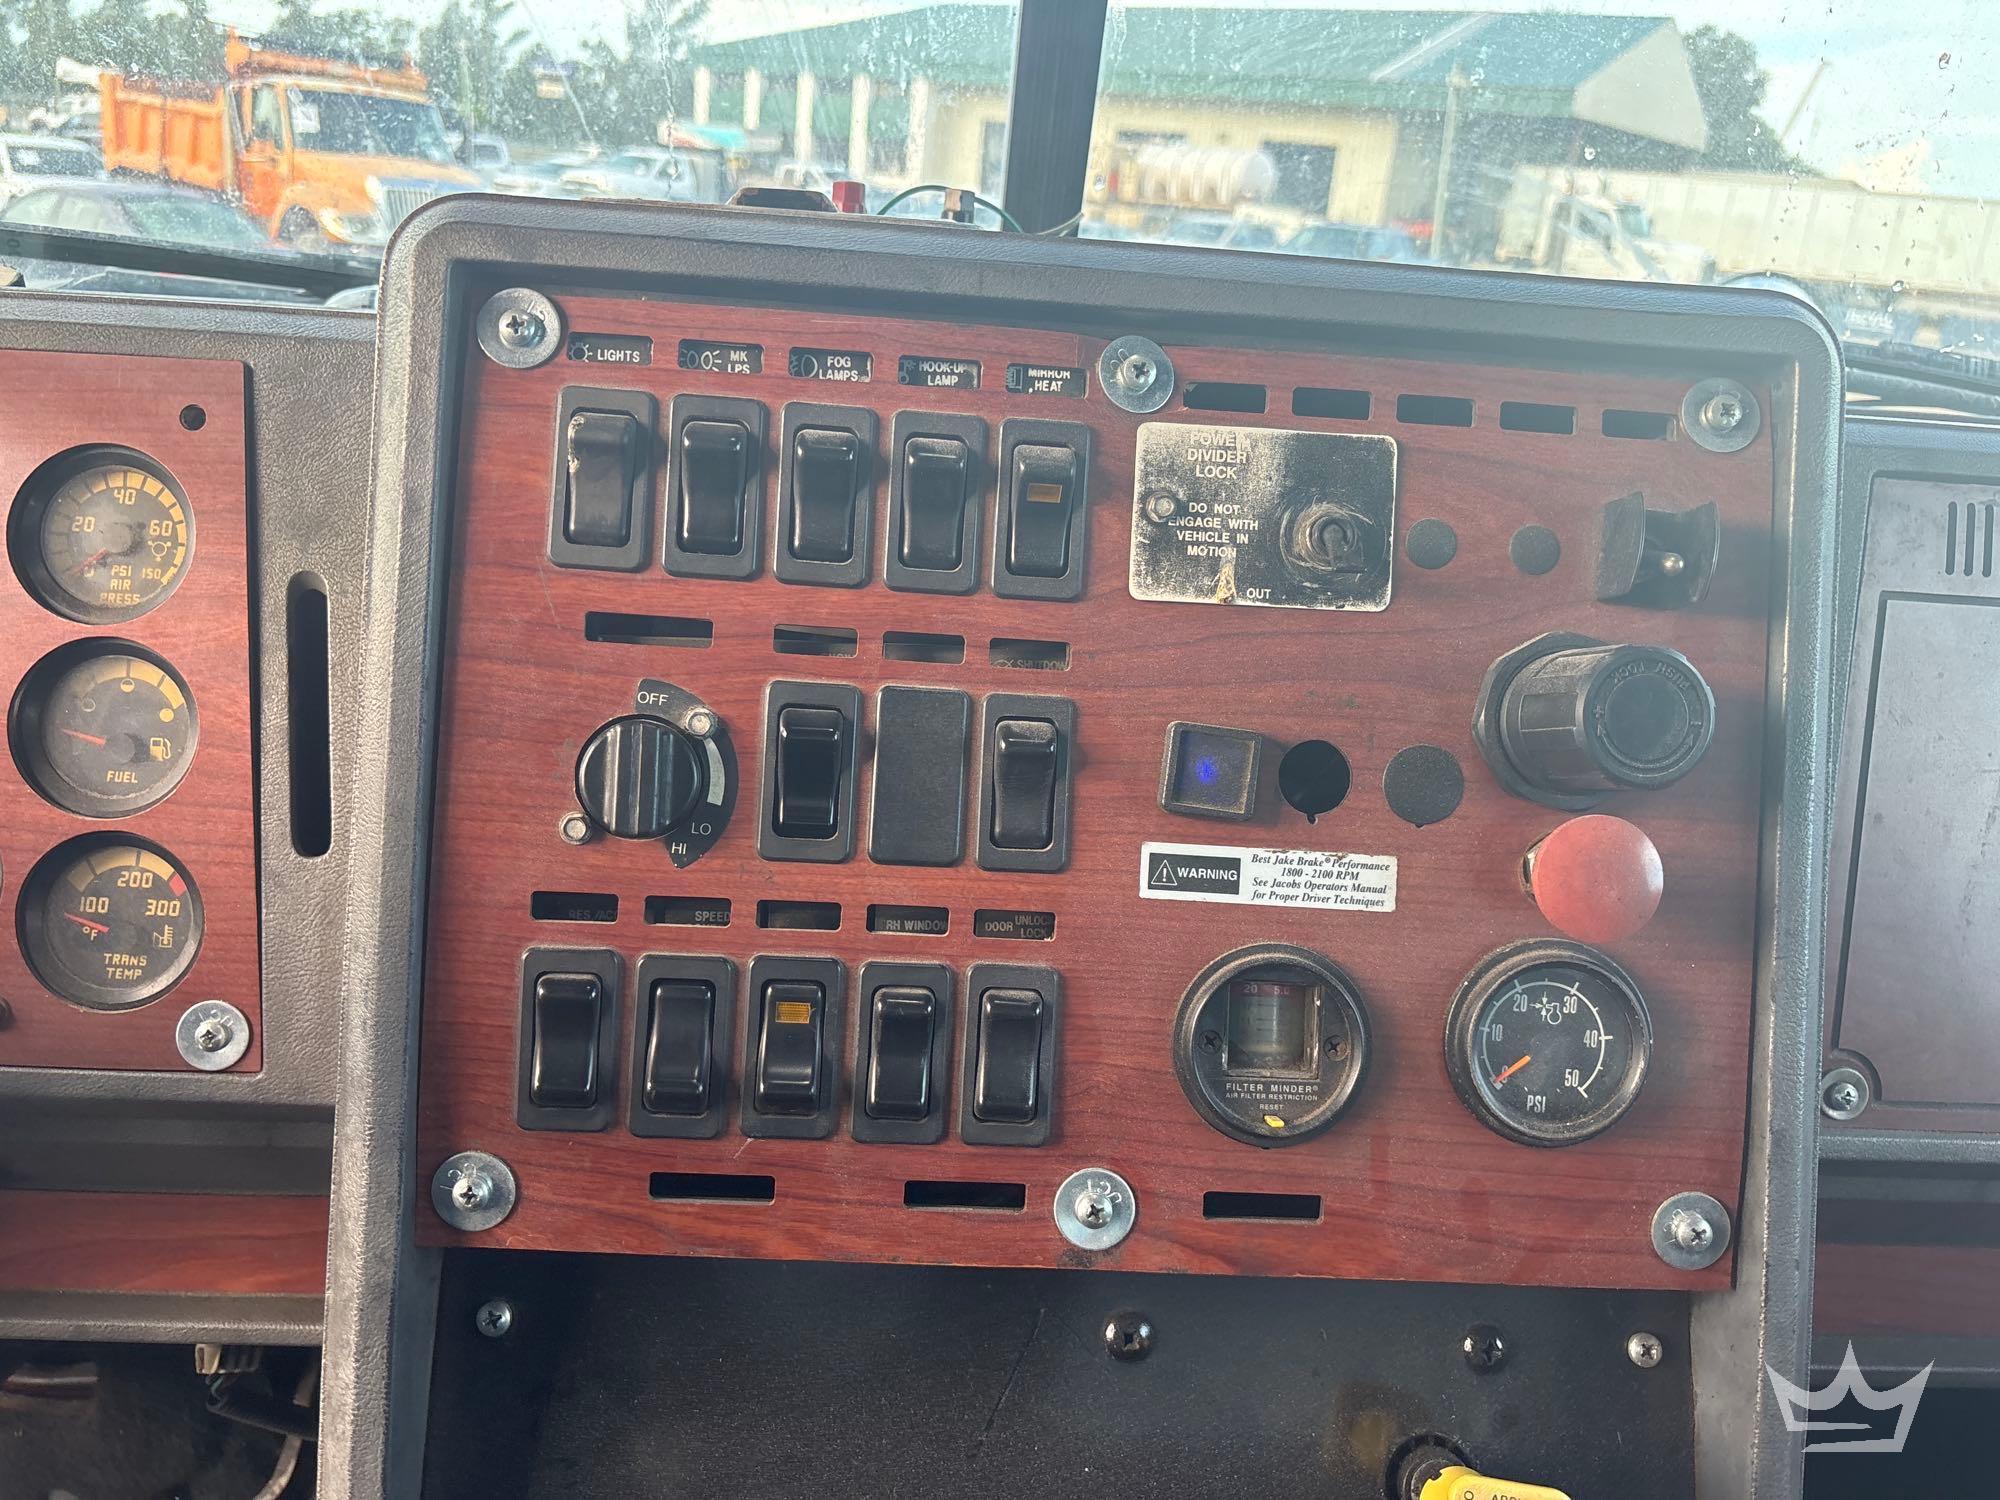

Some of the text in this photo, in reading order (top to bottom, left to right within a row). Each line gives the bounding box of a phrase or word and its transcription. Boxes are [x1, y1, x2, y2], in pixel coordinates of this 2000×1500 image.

[597, 348, 640, 362] LIGHTS
[730, 350, 748, 362] MK
[827, 356, 851, 368] FOG
[727, 363, 750, 374] LPS
[918, 360, 968, 374] HOOK-UP
[818, 368, 858, 382] LAMPS
[927, 374, 958, 386] LAMP
[1035, 380, 1062, 392] HEAT
[1187, 448, 1247, 464] DIVIDER
[1195, 466, 1237, 480] LOCK
[114, 489, 136, 506] 40
[1188, 502, 1240, 515] DO NOT
[72, 516, 95, 532] 20
[150, 520, 173, 536] 60
[1168, 516, 1258, 531] ENGAGE WITH
[1177, 530, 1248, 544] VEHICLE IN
[1187, 545, 1236, 558] MOTION
[111, 564, 132, 576] PSI
[141, 568, 161, 580] 150
[110, 579, 131, 590] AIR
[100, 592, 140, 604] PRESS
[1246, 588, 1272, 600] OUT
[637, 691, 669, 706] OFF
[106, 770, 138, 784] FUEL
[692, 822, 712, 836] LO
[672, 843, 687, 854] HI
[1251, 854, 1271, 864] Best
[1273, 854, 1294, 866] Jake
[1332, 858, 1390, 872] Performance
[117, 871, 154, 888] 200
[1177, 866, 1238, 881] WARNING
[1281, 868, 1302, 878] 1800
[1312, 868, 1333, 879] 2100
[1336, 870, 1360, 881] RPM
[1252, 877, 1388, 894] See Jacobs Operators Manual
[80, 896, 110, 914] 100
[1252, 890, 1385, 908] for Proper Driver Techniques
[144, 899, 181, 917] 300
[695, 910, 731, 922] SPEED
[985, 914, 1051, 932] DOOR UNLOC
[886, 920, 901, 930] RH
[104, 953, 148, 966] TRANS
[106, 968, 142, 980] TEMP
[1513, 994, 1528, 1012] 20
[1563, 996, 1577, 1014] 30
[1491, 1024, 1503, 1042] 10
[1584, 1030, 1598, 1048] 40
[1565, 1069, 1580, 1088] 50
[1226, 1082, 1264, 1092] FILTER
[1526, 1095, 1546, 1113] PSI
